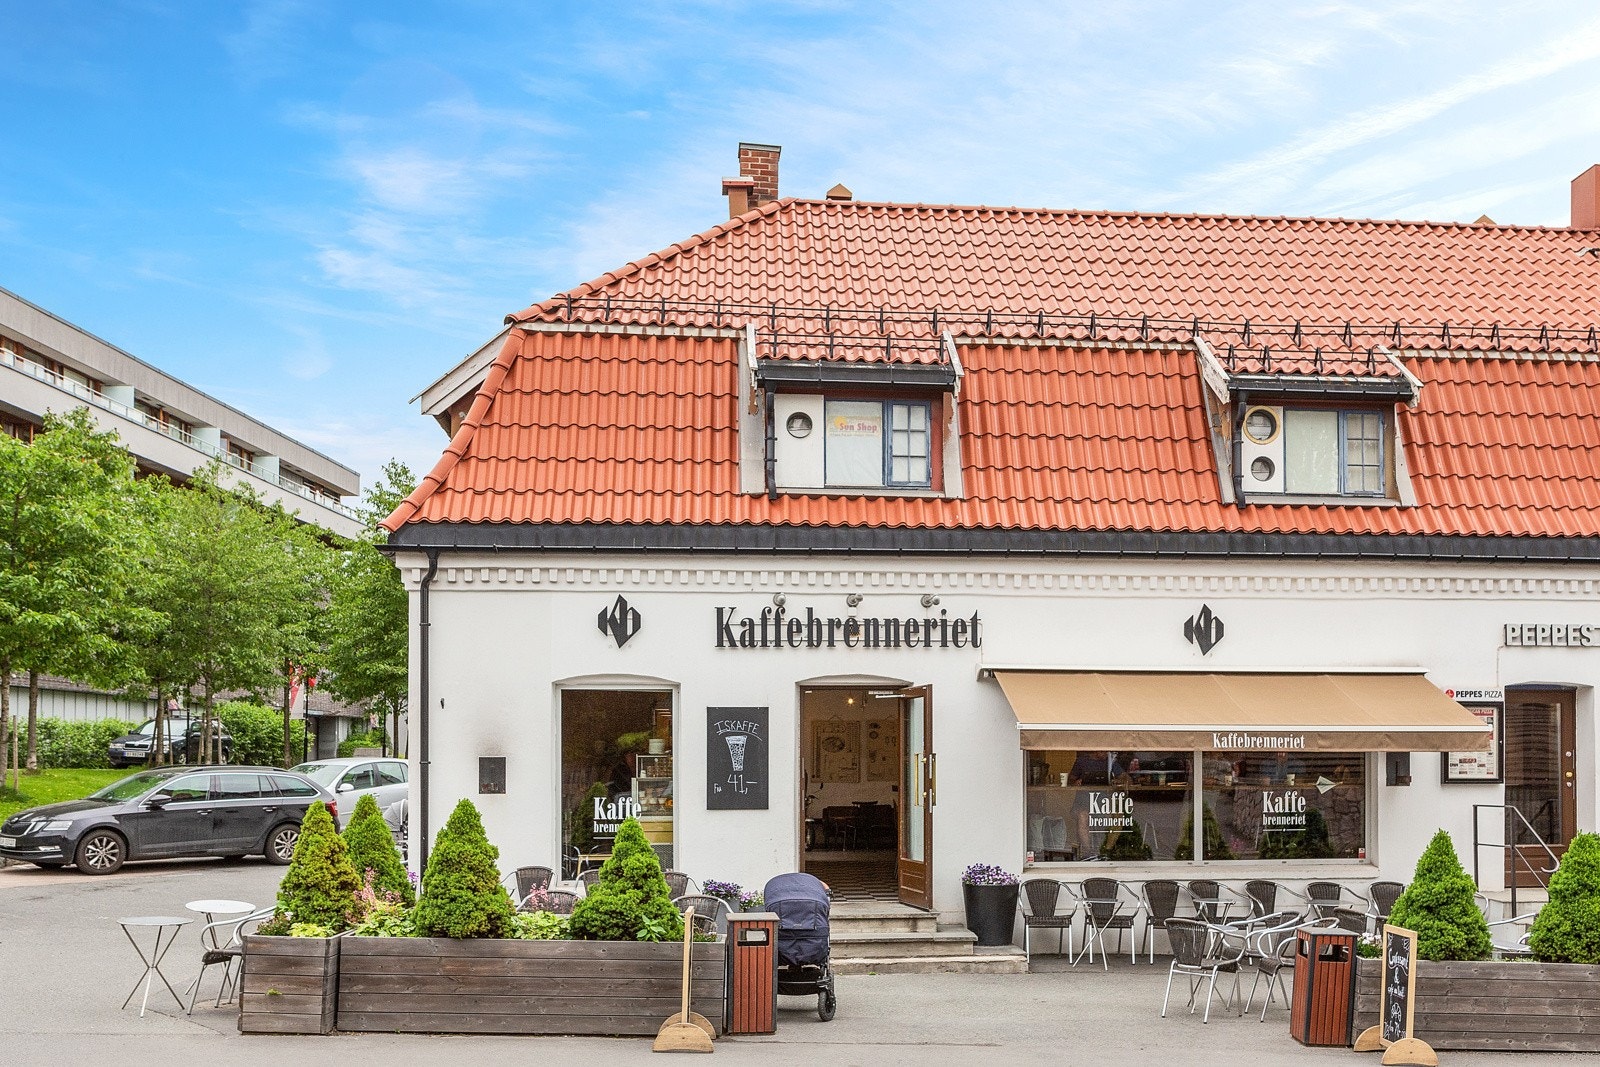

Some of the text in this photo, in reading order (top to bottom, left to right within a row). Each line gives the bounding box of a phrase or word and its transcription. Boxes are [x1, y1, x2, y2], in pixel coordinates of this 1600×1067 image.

[839, 422, 877, 433] Sun Shop
[715, 606, 982, 648] Kaffebrenneriet
[1456, 690, 1482, 698] PEPPES
[714, 720, 760, 735] ISKAFFE
[1213, 732, 1305, 749] Kaffebrenneriet
[593, 796, 642, 820] Kaffe
[1089, 791, 1134, 814] Kaffe
[1262, 790, 1306, 813] Kaffe
[1089, 815, 1134, 827] brenneriet
[1262, 813, 1306, 826] brenneriet
